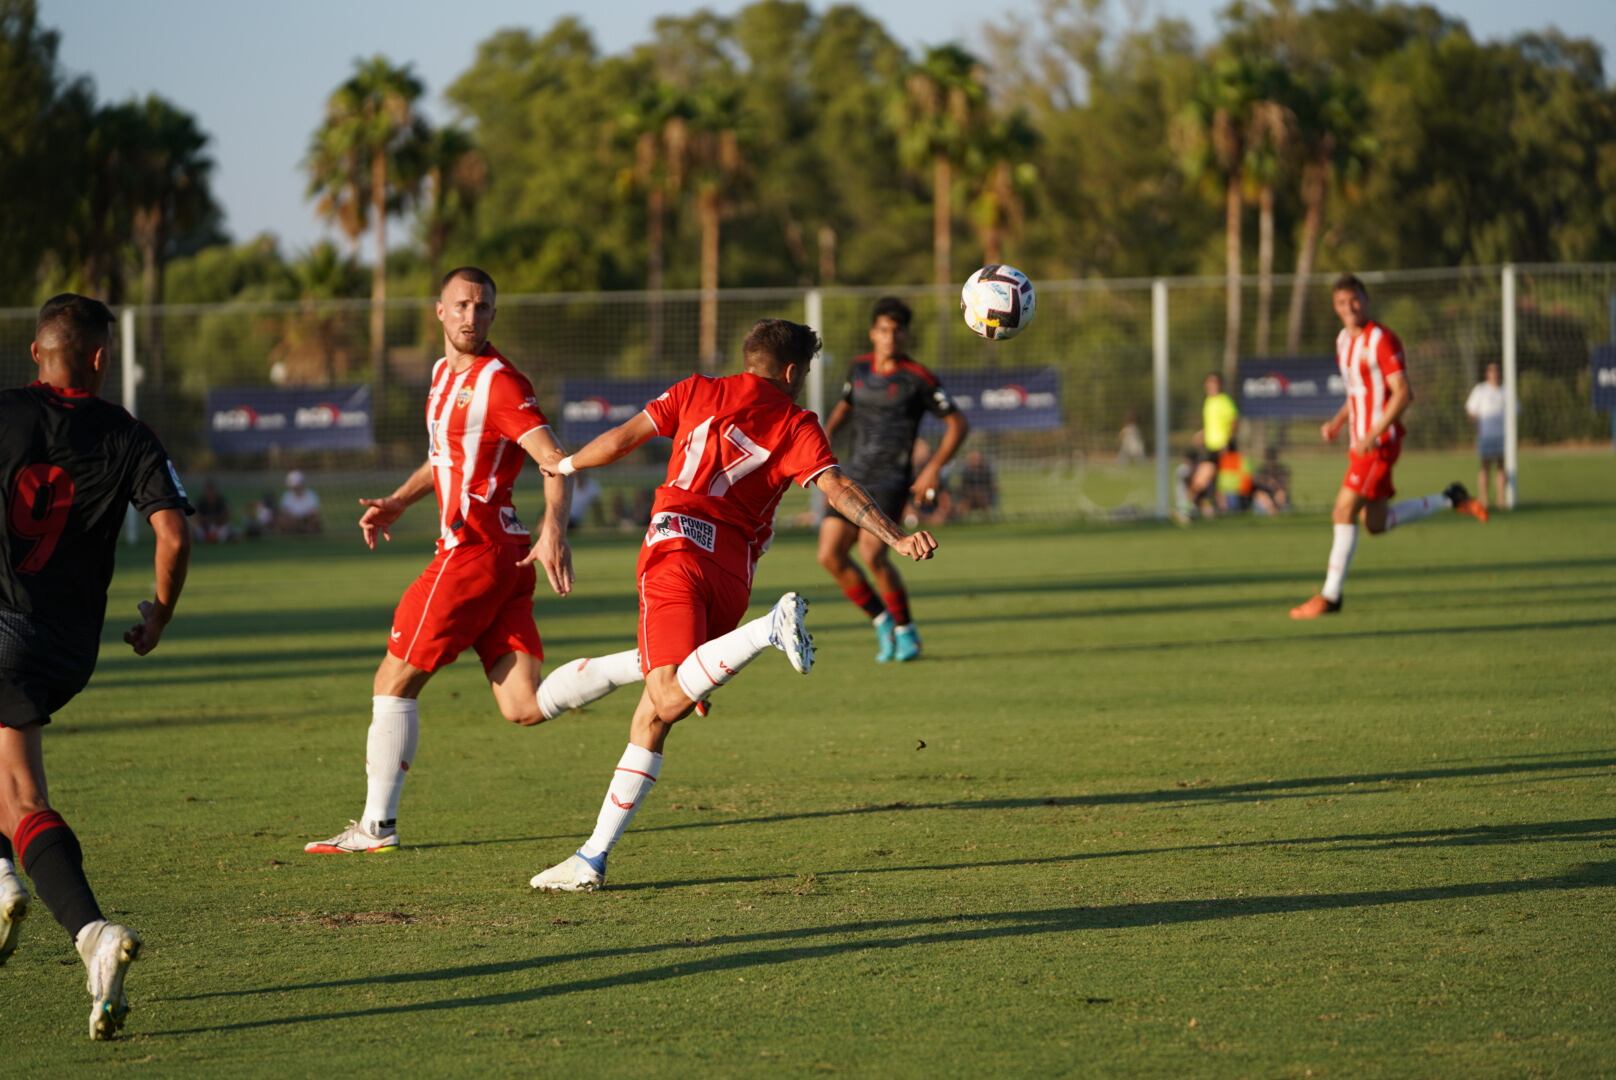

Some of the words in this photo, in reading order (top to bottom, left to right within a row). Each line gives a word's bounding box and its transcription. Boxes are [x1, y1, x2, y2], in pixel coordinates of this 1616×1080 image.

[668, 415, 772, 497] 17
[9, 463, 76, 575] 9
[680, 515, 714, 538] POWER
[682, 526, 712, 550] HORSE
